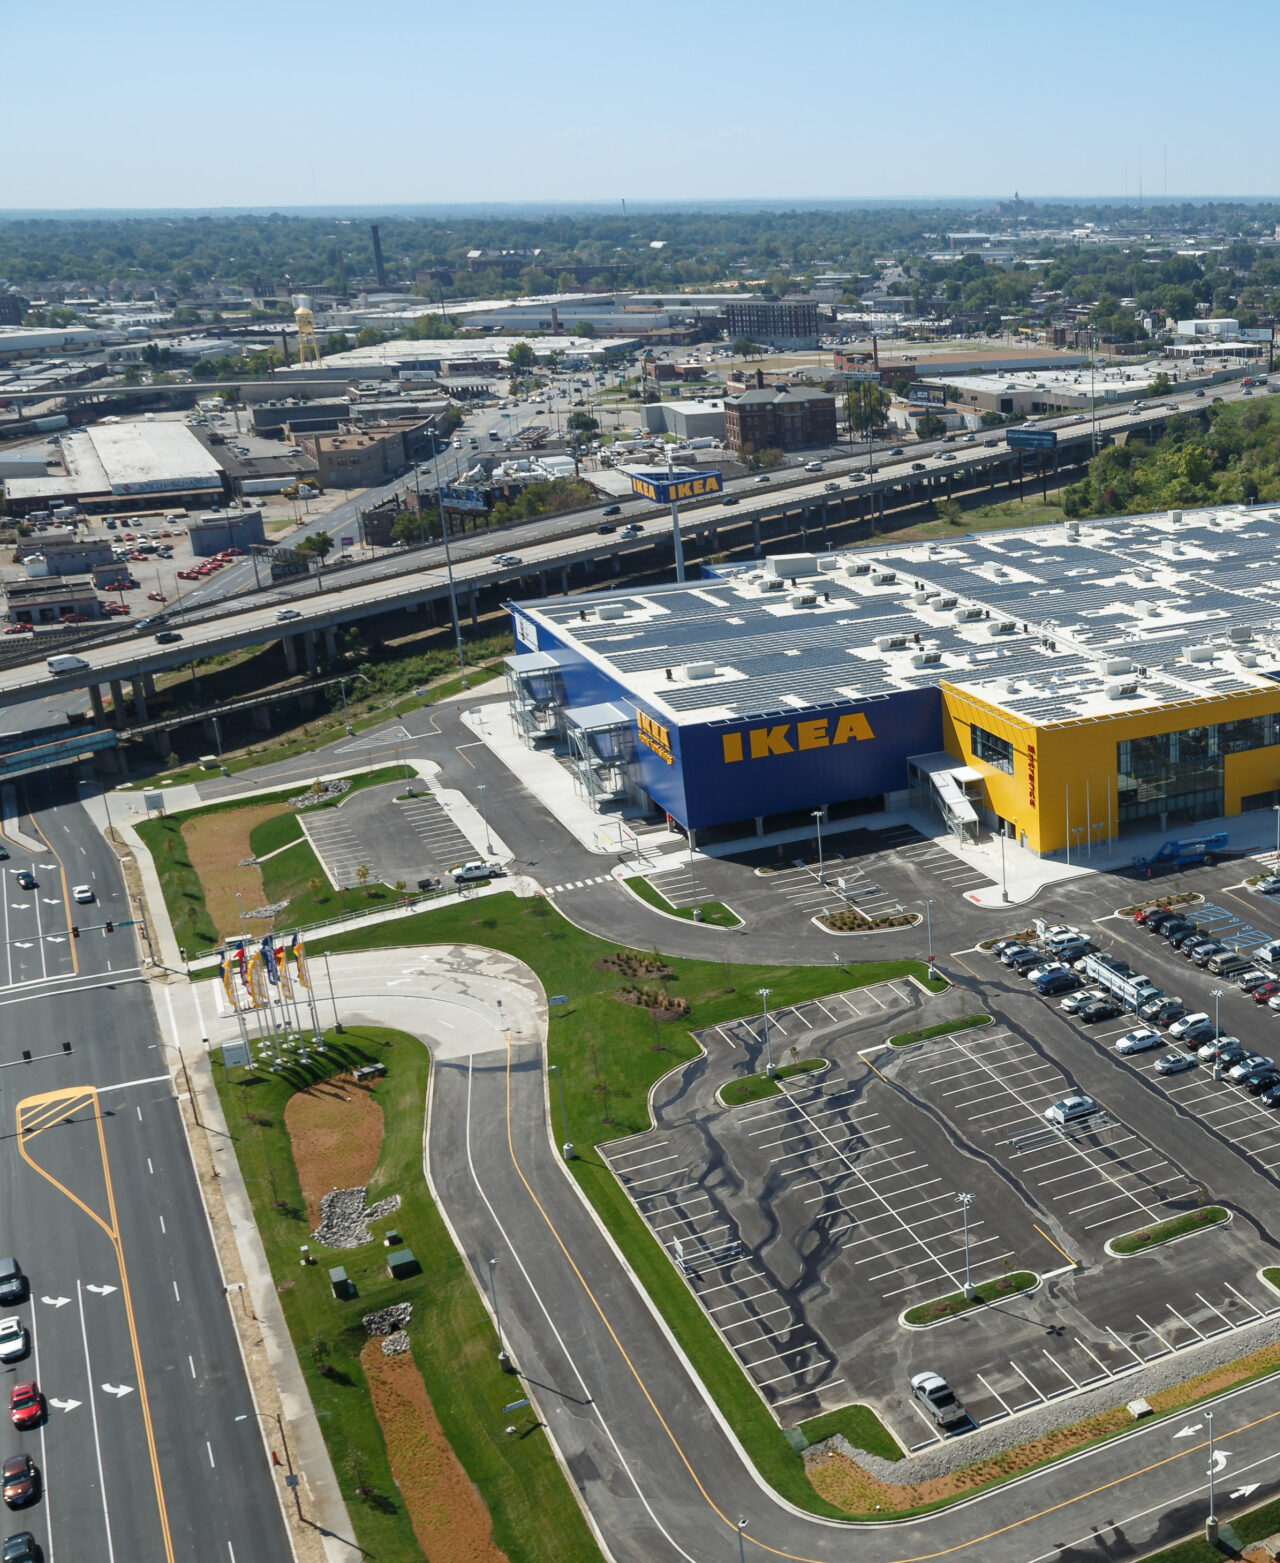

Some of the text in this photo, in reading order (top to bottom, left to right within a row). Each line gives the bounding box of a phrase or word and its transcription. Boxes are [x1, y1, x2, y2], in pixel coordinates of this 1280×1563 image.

[632, 477, 656, 500] IKEA
[669, 476, 719, 500] IKEA
[722, 712, 876, 763] IKEA
[1027, 743, 1036, 809] Entrance
